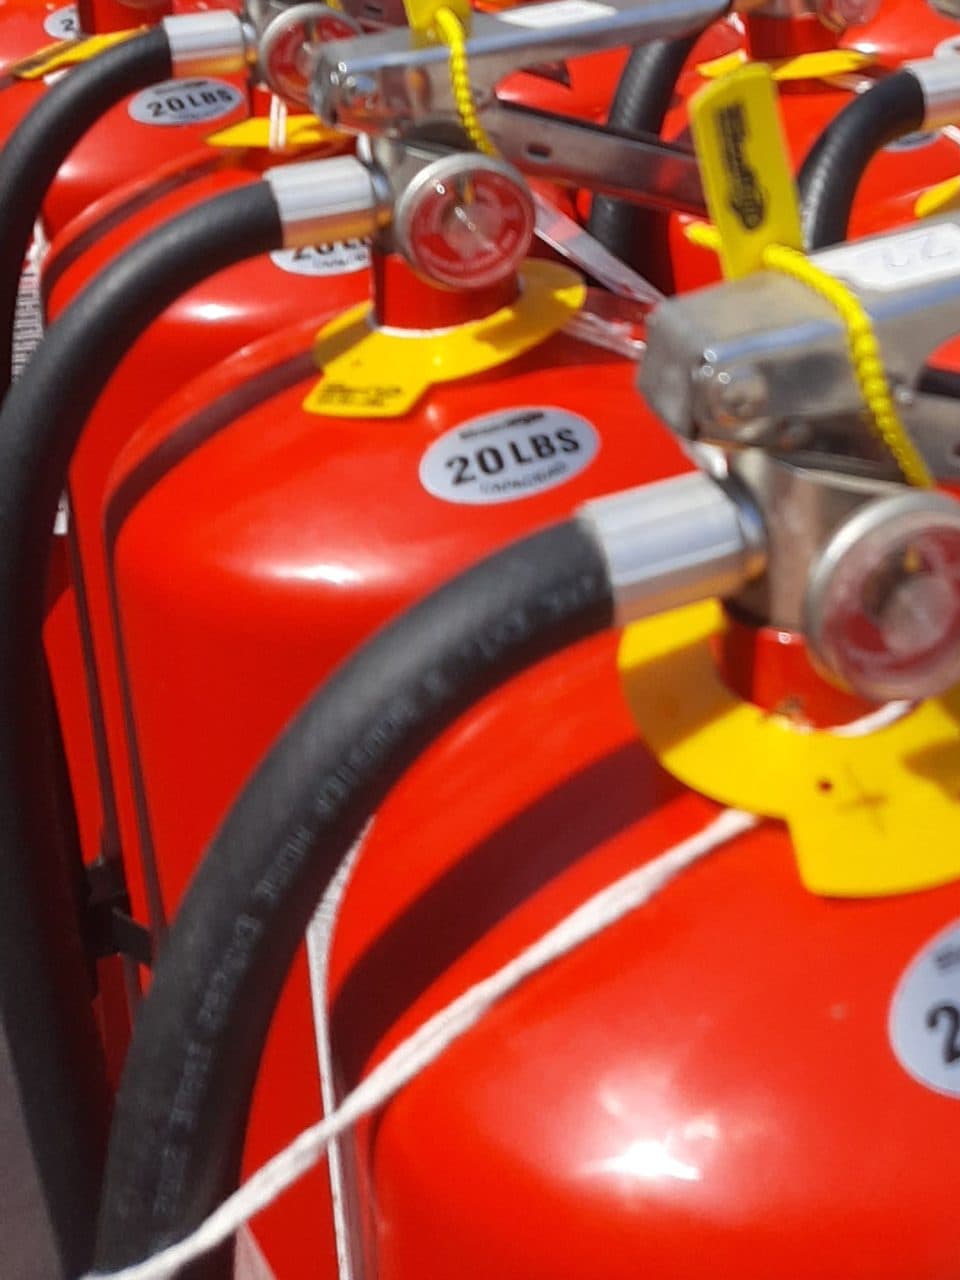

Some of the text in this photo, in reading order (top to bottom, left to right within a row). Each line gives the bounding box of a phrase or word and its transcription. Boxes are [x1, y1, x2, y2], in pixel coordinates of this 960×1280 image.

[147, 89, 233, 117] 20 LBS
[445, 428, 580, 485] 20 LBS
